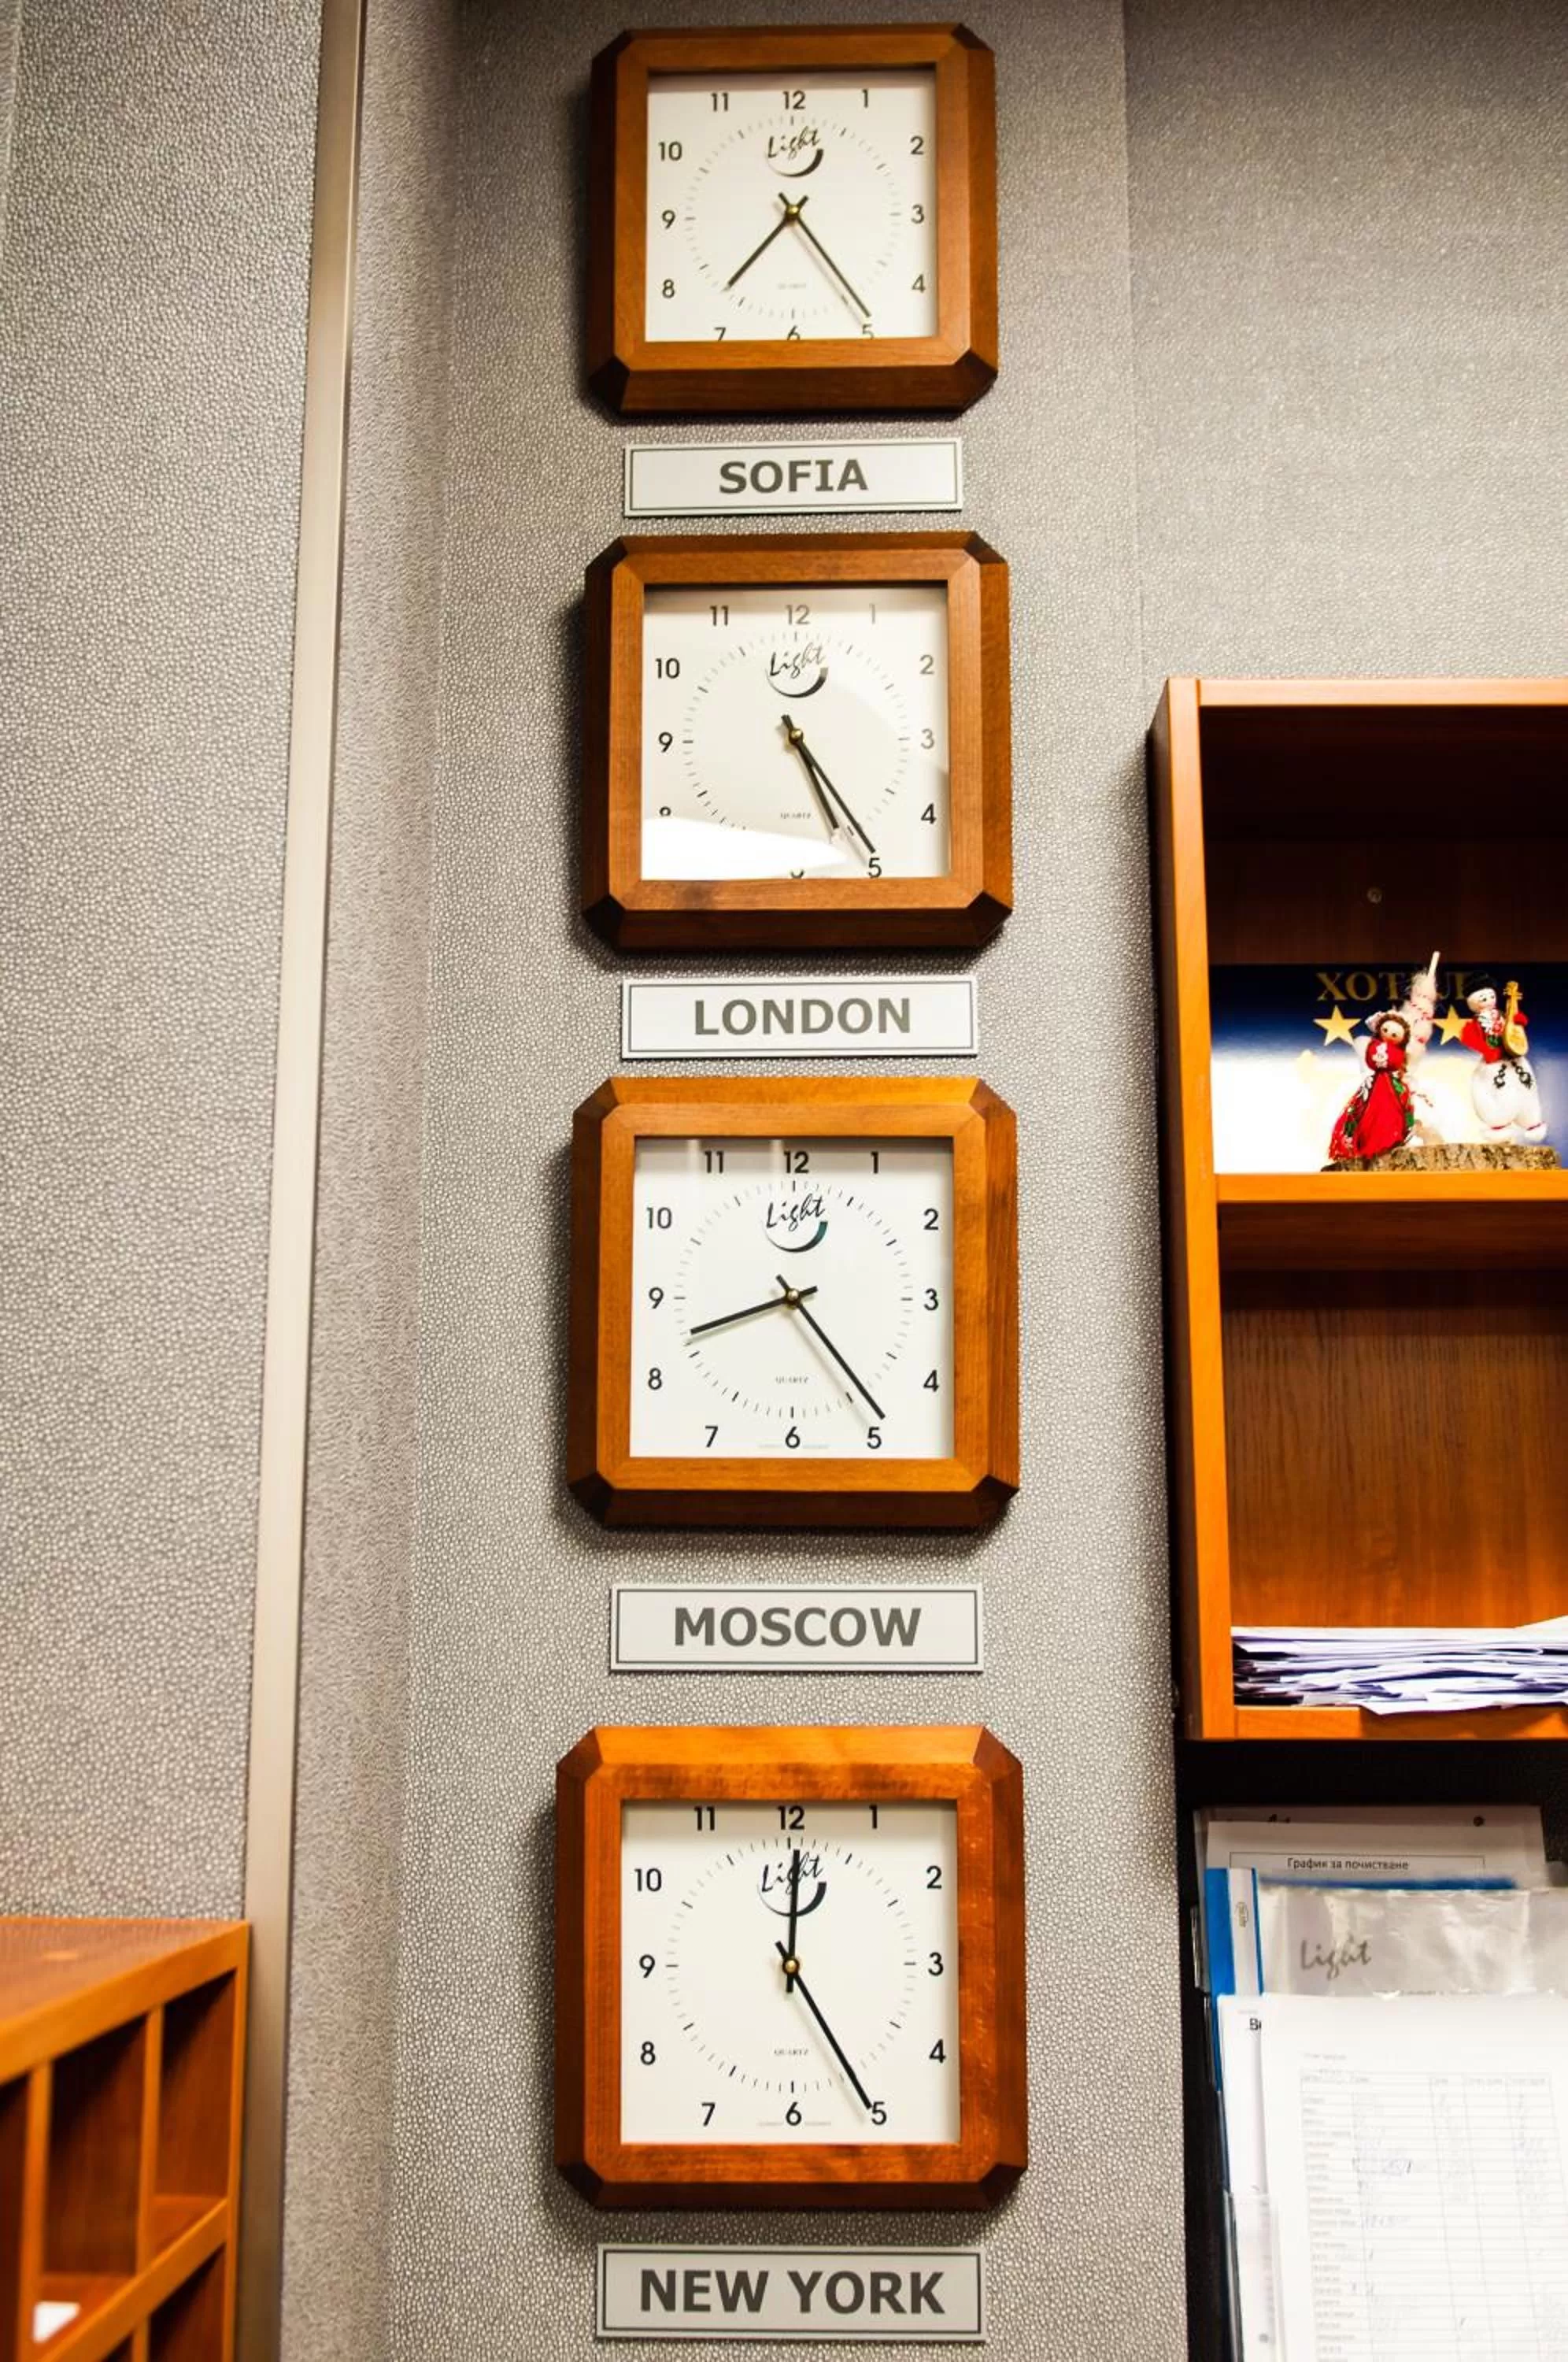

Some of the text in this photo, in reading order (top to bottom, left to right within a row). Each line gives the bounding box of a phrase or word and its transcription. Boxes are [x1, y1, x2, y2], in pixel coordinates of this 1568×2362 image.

[711, 92, 729, 112] 11
[783, 90, 805, 109] 12
[862, 89, 869, 108] 1
[660, 142, 682, 161] 10
[767, 126, 820, 160] Light
[911, 136, 924, 155] 2
[662, 210, 675, 228] 9
[912, 205, 925, 224] 3
[663, 280, 675, 298] 8
[912, 274, 926, 292] 4
[714, 328, 727, 341] 7
[862, 324, 875, 339] 5
[719, 460, 867, 494] SOFIA
[709, 605, 729, 626] 11
[785, 605, 810, 624] 12
[869, 604, 876, 624] 1
[656, 658, 679, 679] 10
[770, 642, 825, 679] Light
[920, 655, 934, 674] 2
[659, 732, 672, 752] 9
[921, 729, 935, 750] 3
[921, 804, 936, 824] 4
[868, 857, 882, 878] 5
[1316, 972, 1470, 1001] ХОТЛ
[695, 998, 909, 1035] LONDON
[704, 1151, 724, 1173] 11
[783, 1151, 809, 1173] 12
[871, 1151, 878, 1173] 1
[647, 1208, 671, 1229] 10
[766, 1194, 825, 1231] Light
[924, 1209, 938, 1230] 2
[649, 1287, 664, 1309] 9
[925, 1288, 938, 1310] 3
[648, 1368, 662, 1390] 8
[923, 1370, 939, 1392] 4
[705, 1426, 718, 1447] 7
[786, 1427, 800, 1449] 6
[867, 1427, 882, 1449] 5
[675, 1608, 921, 1647] MOSCOW
[694, 1806, 715, 1831] 11
[778, 1805, 805, 1830] 12
[869, 1805, 878, 1829] 1
[1288, 1858, 1325, 1869] График
[1345, 1860, 1408, 1869] почистване
[635, 1868, 661, 1891] 10
[927, 1866, 941, 1889] 2
[639, 1955, 655, 1978] 9
[929, 1953, 943, 1976] 3
[1300, 1935, 1370, 1979] Light
[641, 2042, 655, 2065] 8
[930, 2039, 946, 2063] 4
[702, 2103, 715, 2126] 7
[786, 2102, 801, 2126] 6
[871, 2101, 886, 2125] 5
[642, 2270, 945, 2314] NEW YORK
